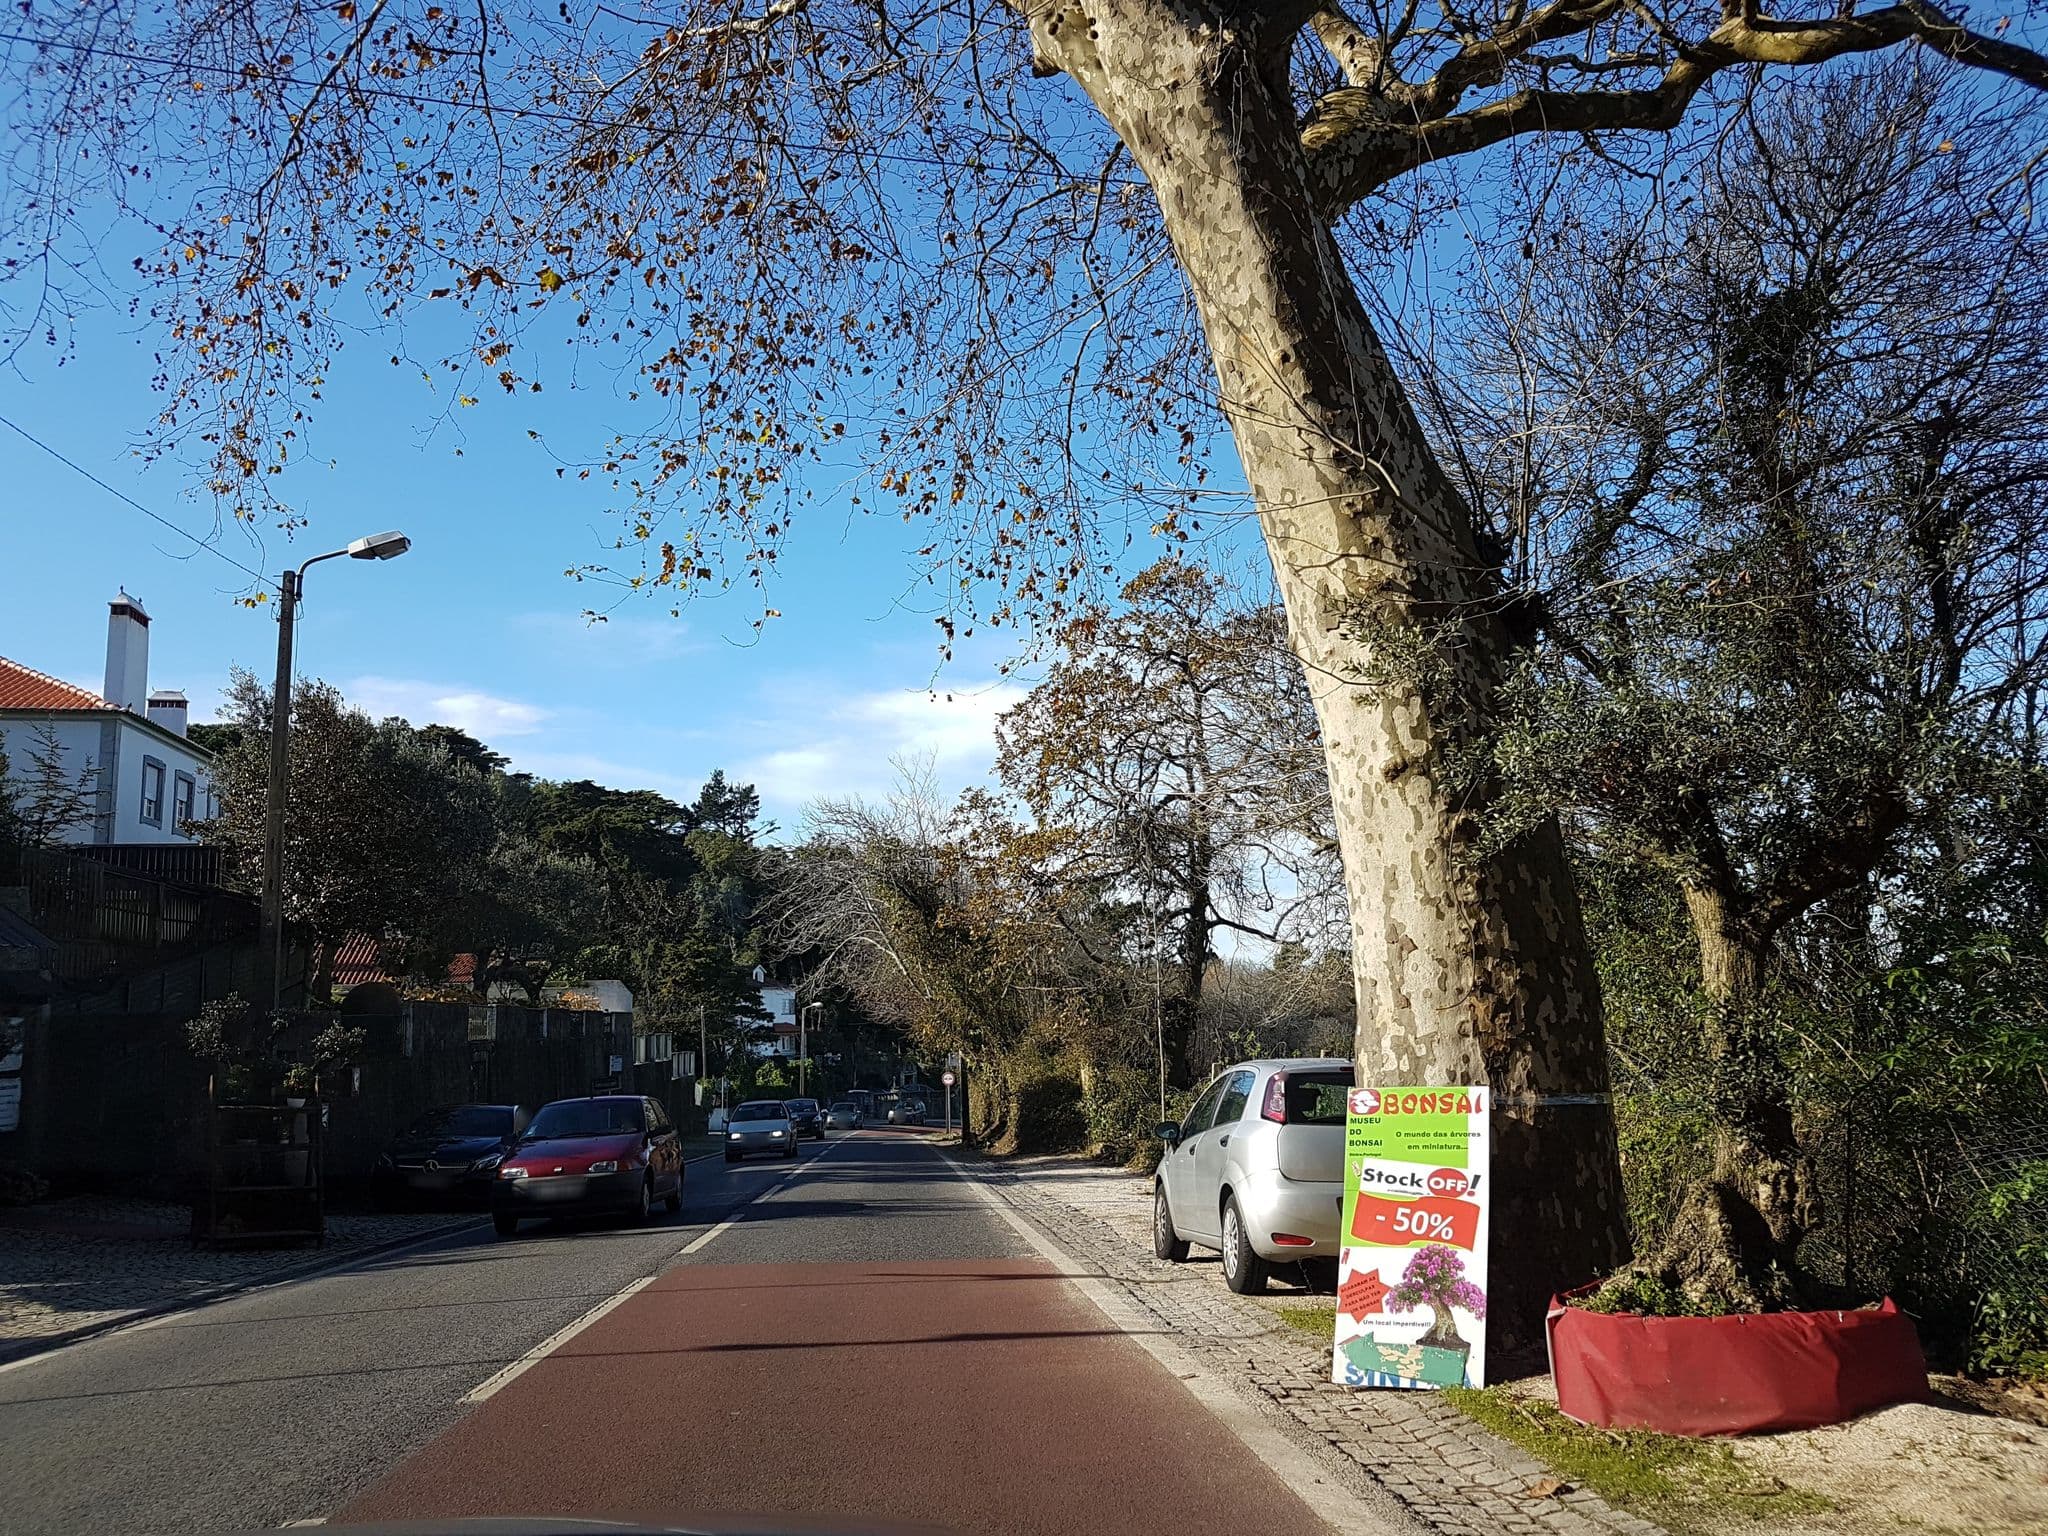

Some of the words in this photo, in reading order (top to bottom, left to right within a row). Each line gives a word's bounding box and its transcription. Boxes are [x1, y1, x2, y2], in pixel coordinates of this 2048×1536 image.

[1383, 1092, 1483, 1115] BONSAI
[1349, 1139, 1383, 1147] BONSAI
[1403, 1130, 1431, 1138] mundo
[1433, 1130, 1448, 1138] das
[1362, 1167, 1424, 1189] Stock
[1392, 1206, 1455, 1241] 50%
